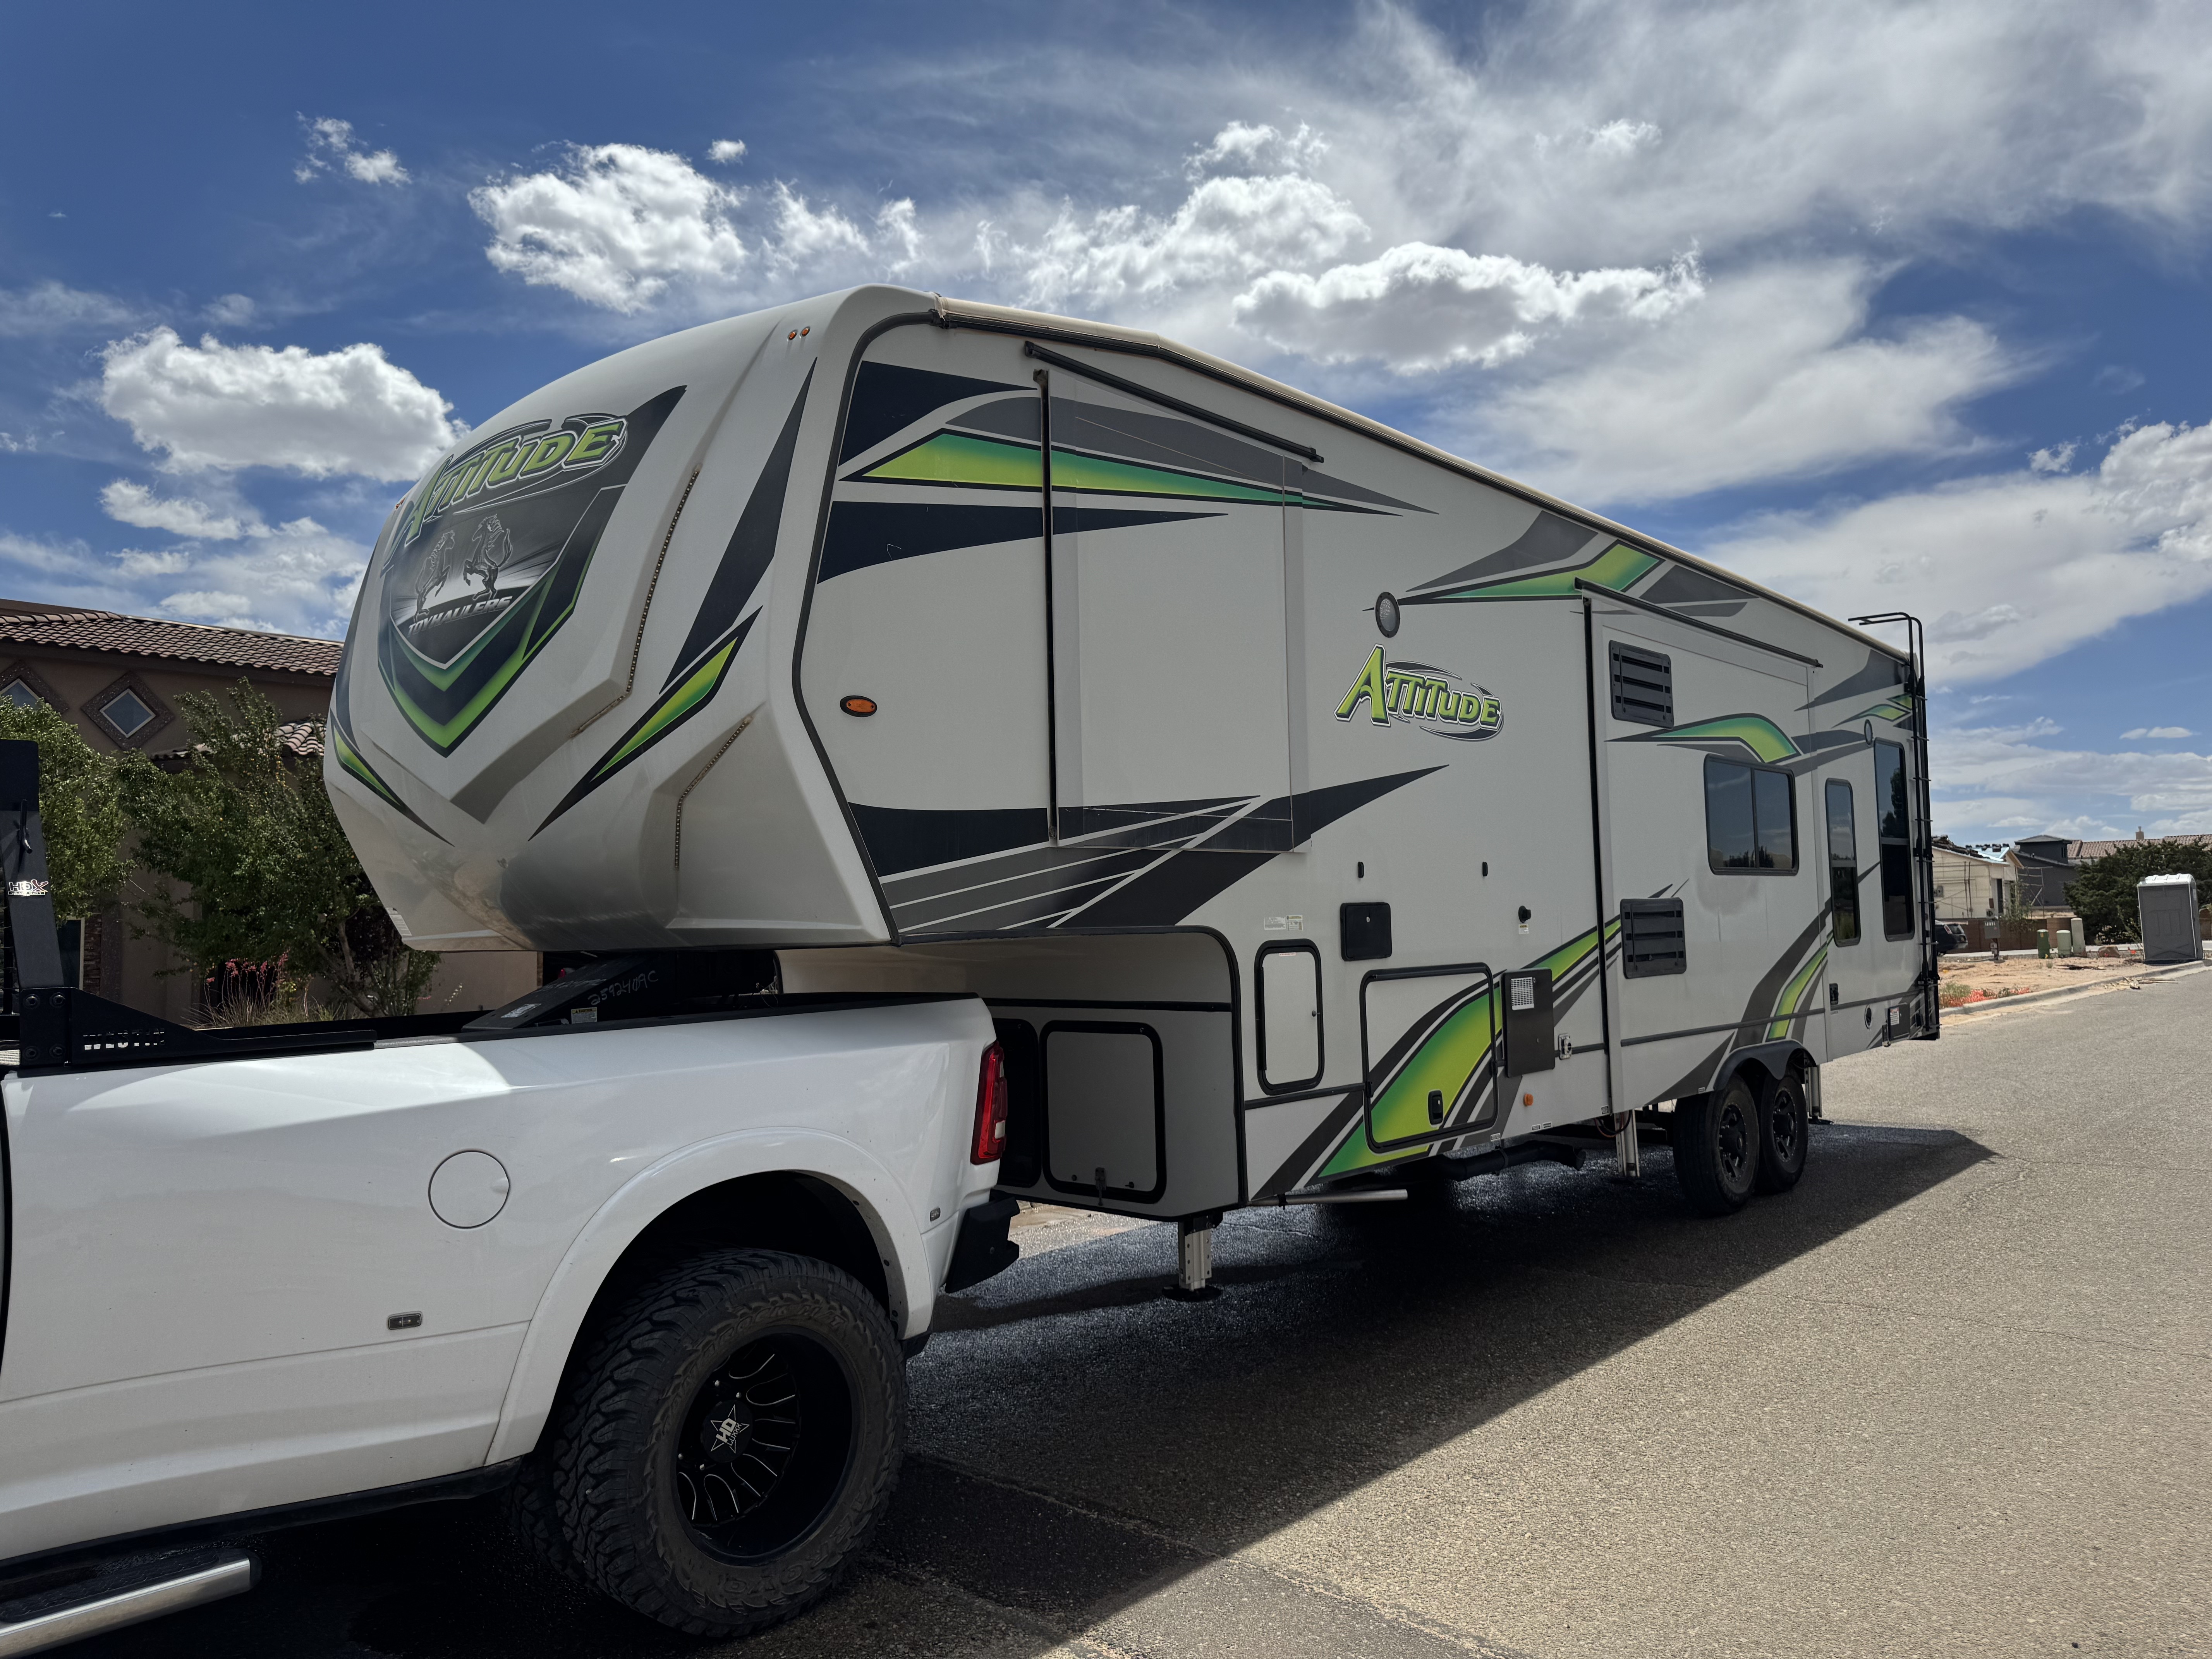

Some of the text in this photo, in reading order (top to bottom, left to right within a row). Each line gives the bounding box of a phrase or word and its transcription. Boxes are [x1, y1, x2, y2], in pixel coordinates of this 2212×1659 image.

[381, 416, 628, 576] ATTITUDE
[1334, 644, 1502, 731] ATTITUDE
[716, 1418, 737, 1443] HD
